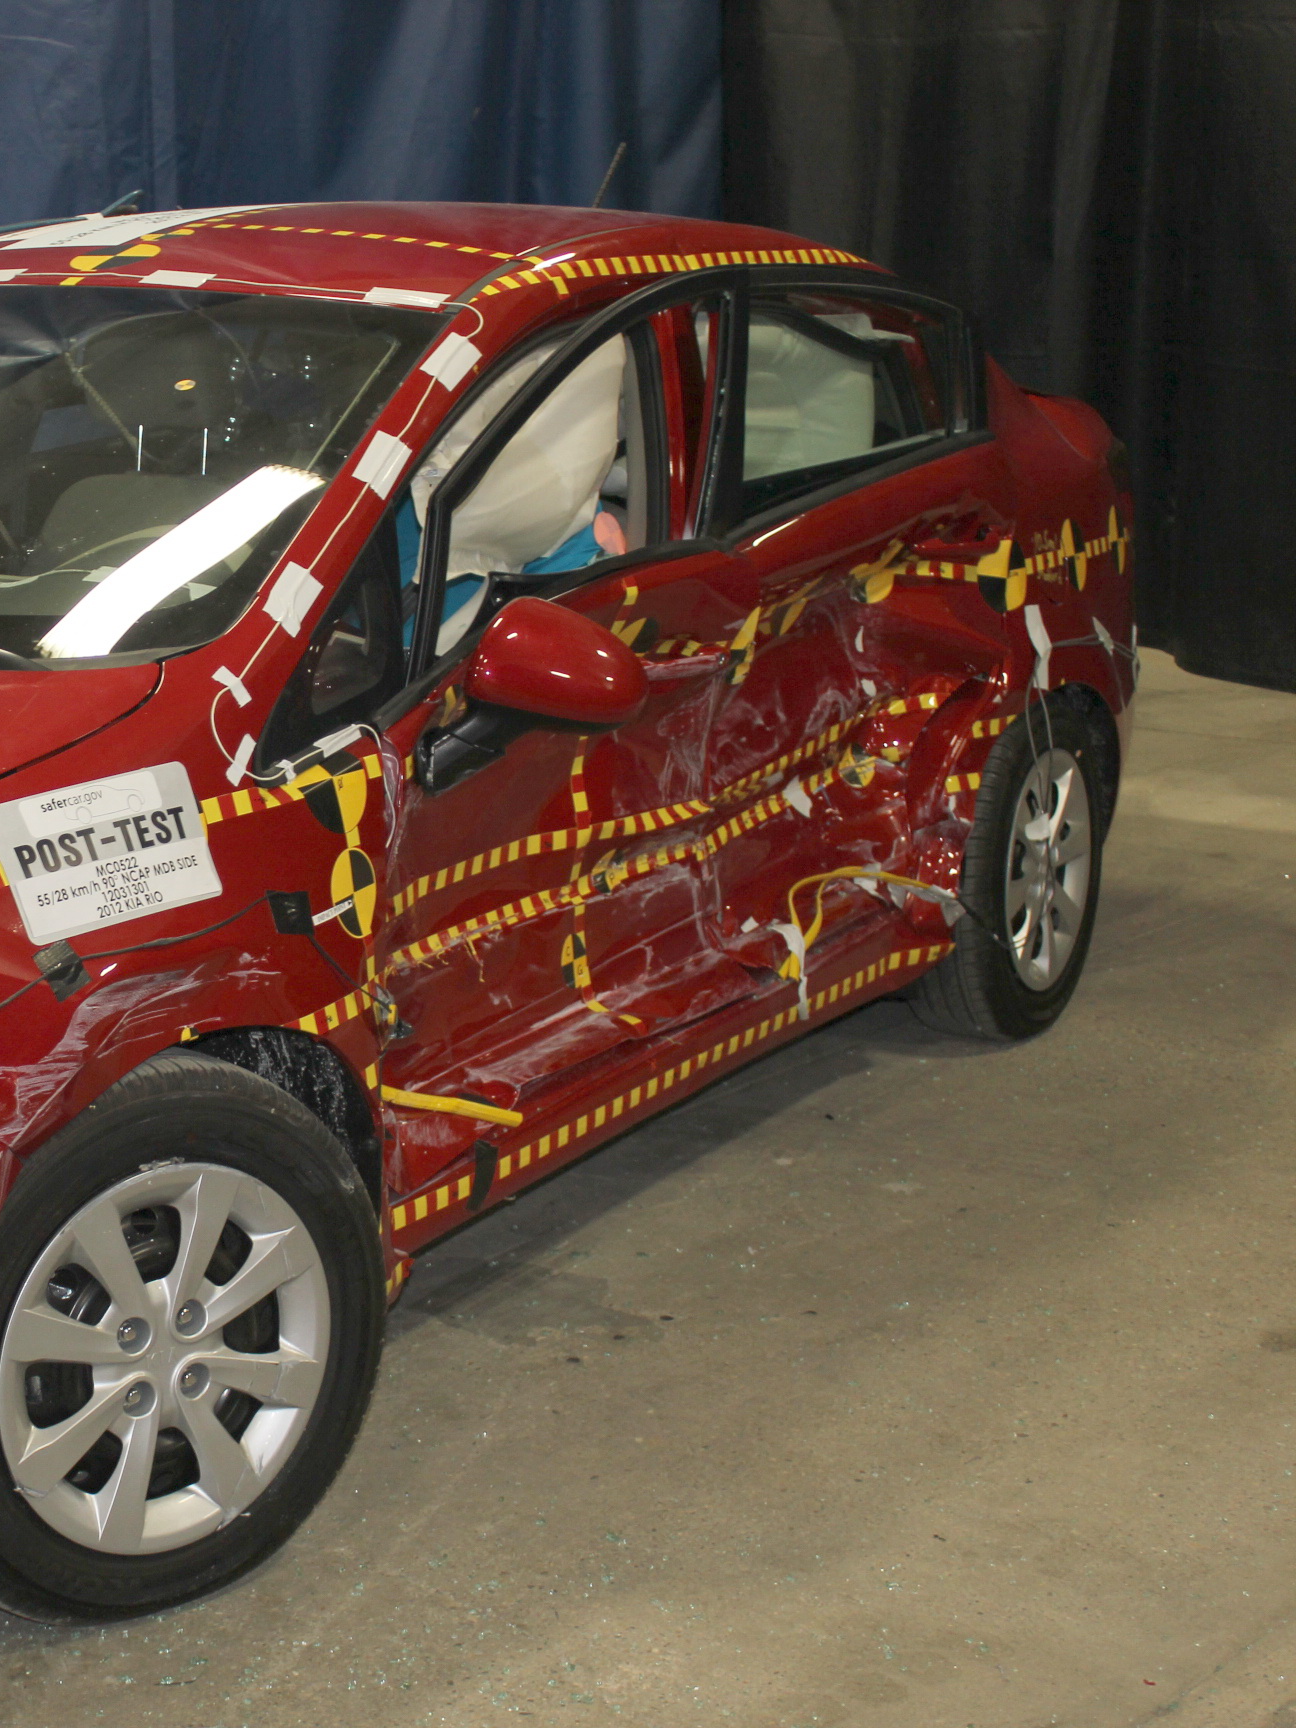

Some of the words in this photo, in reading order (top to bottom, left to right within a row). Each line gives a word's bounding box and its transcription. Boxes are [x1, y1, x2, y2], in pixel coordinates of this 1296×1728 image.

[40, 788, 103, 813] safercar.gov
[13, 806, 187, 879] POST-TEST
[96, 856, 139, 876] MC0522
[37, 888, 69, 907] 55/28
[71, 880, 101, 898] km/h
[122, 866, 150, 883] NCAP
[153, 861, 176, 877] MDB
[178, 855, 199, 871] SIDE
[102, 881, 150, 903] 12031301
[97, 903, 124, 919] 2012
[125, 896, 144, 912] KIA
[145, 890, 163, 906] RIO
